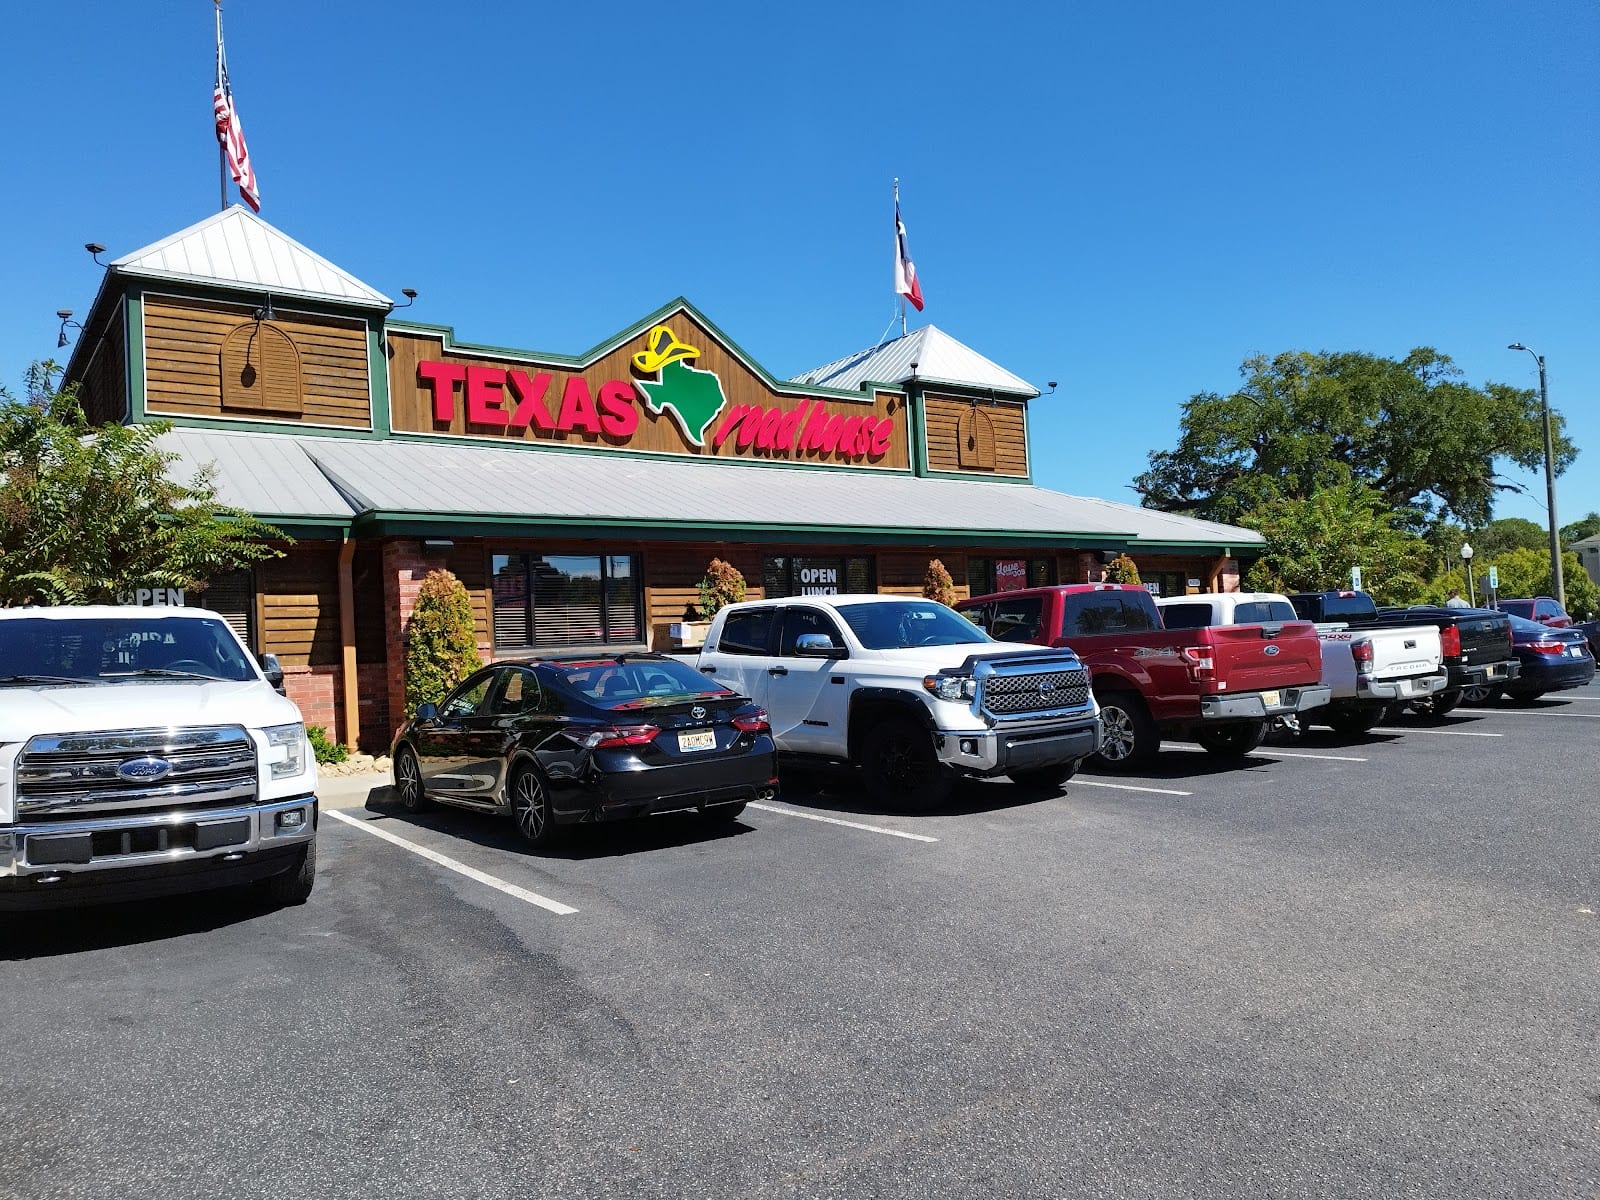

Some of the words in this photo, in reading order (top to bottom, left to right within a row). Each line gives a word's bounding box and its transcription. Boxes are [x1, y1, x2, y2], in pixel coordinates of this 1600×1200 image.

[417, 360, 640, 438] TEXAS
[800, 568, 837, 583] OPEN
[1390, 663, 1427, 671] TACOMA
[130, 764, 160, 775] Ford
